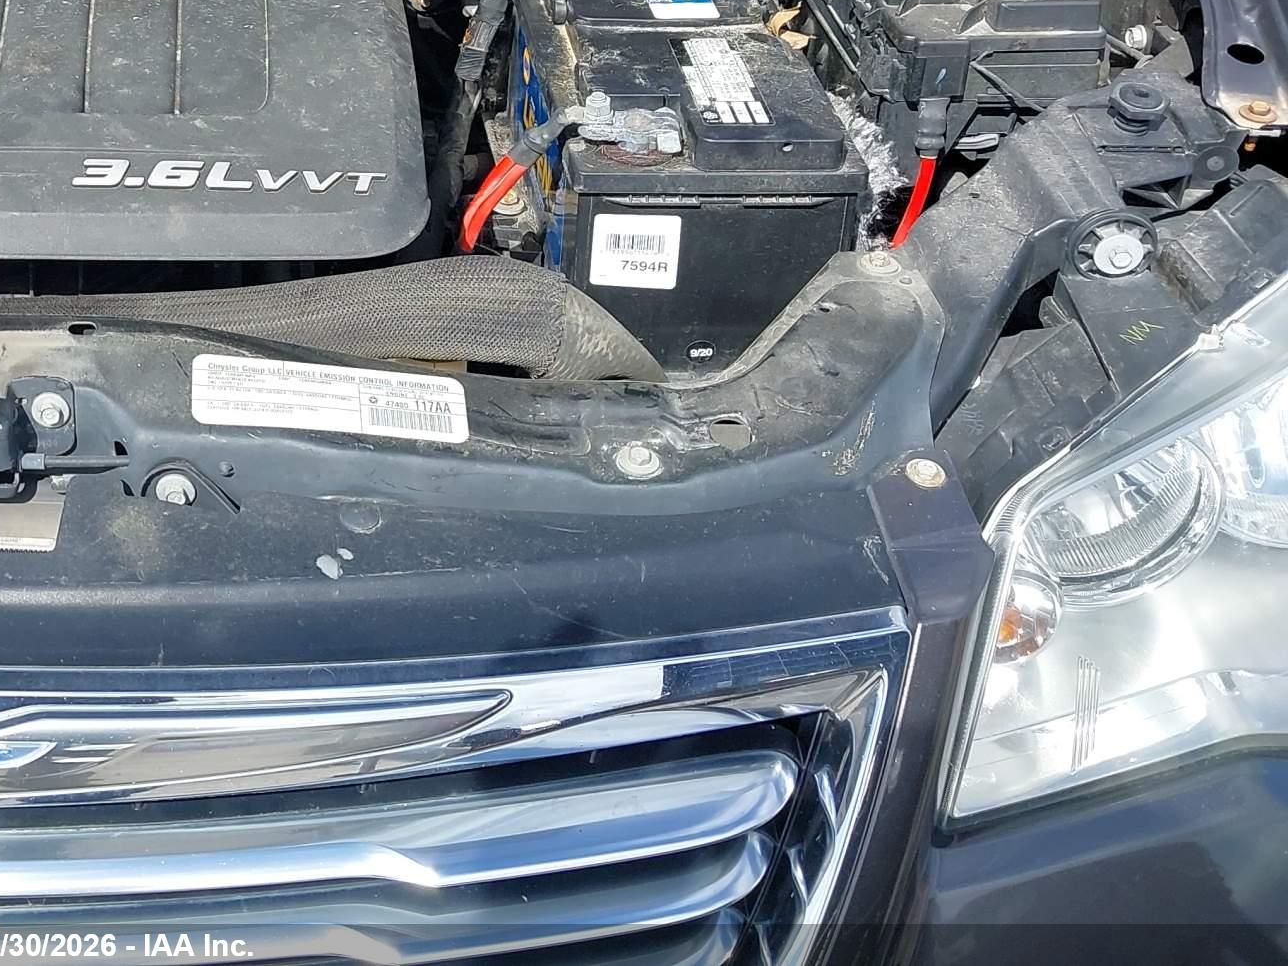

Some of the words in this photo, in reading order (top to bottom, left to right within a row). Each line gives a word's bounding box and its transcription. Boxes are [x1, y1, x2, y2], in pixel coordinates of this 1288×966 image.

[72, 158, 254, 192] 3.6L
[256, 169, 388, 195] VVT
[620, 260, 669, 272] 7594R
[690, 348, 713, 358] 9/20
[207, 362, 240, 372] Chrysler
[242, 365, 265, 374] Group
[268, 367, 282, 375] LLC
[285, 369, 316, 378] VEHICLE
[319, 372, 356, 383] EMISSION
[358, 376, 394, 387] CONTROL
[396, 380, 449, 392] INFORMATION
[413, 400, 451, 414] 117AA
